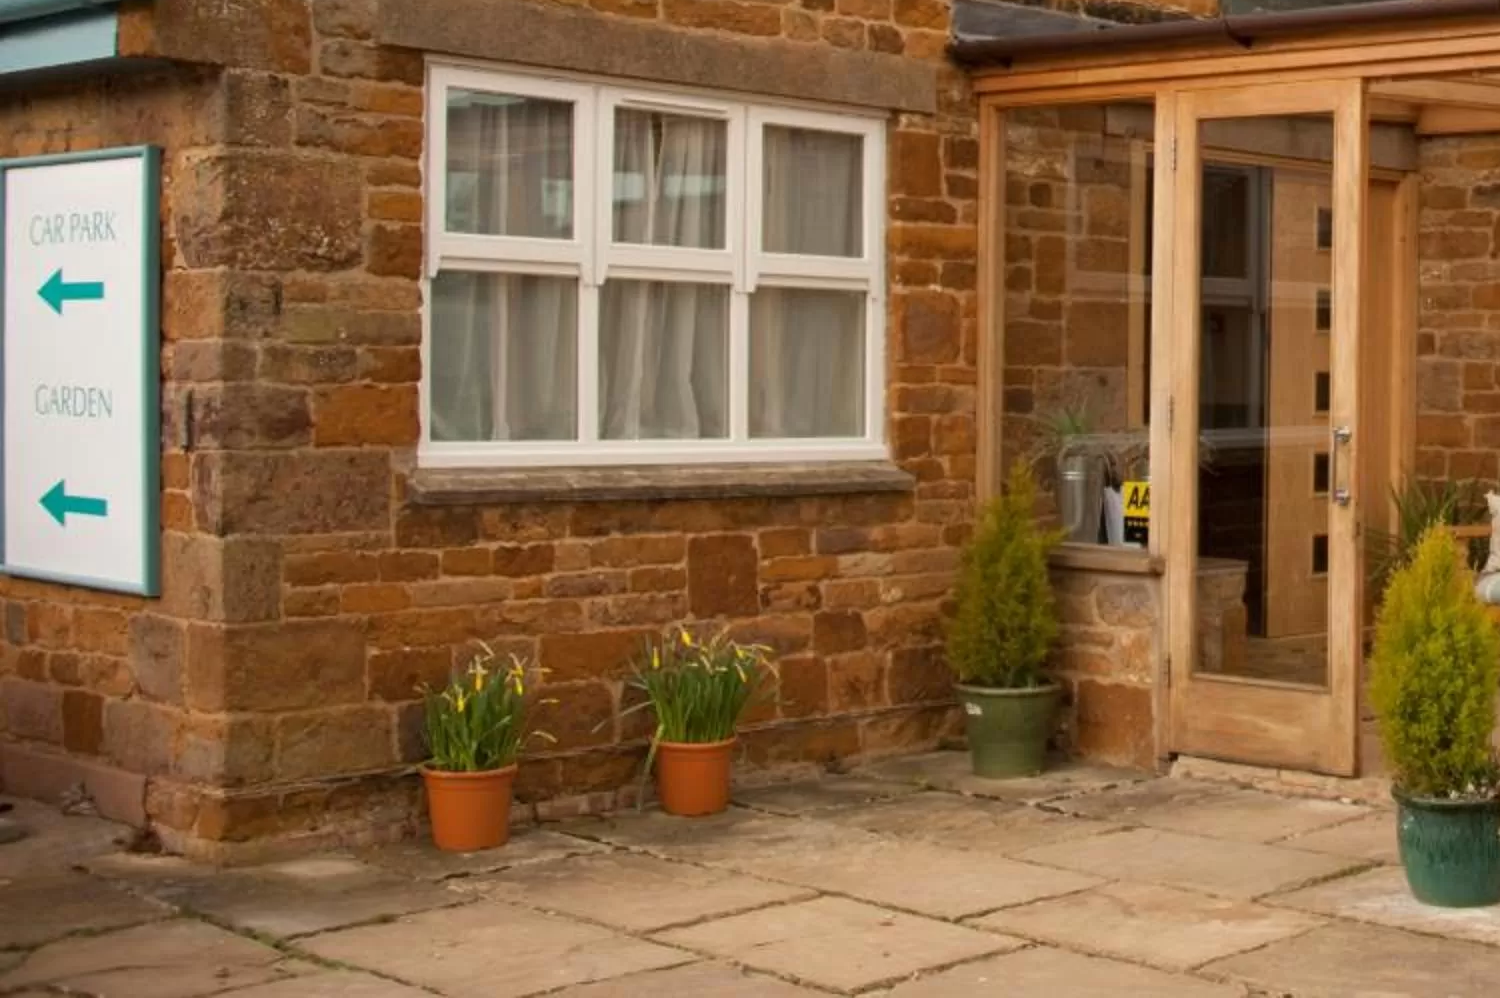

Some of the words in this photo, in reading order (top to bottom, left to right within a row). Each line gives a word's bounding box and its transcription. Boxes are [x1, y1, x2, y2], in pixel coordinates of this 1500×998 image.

[29, 213, 65, 246] CAR
[69, 210, 116, 242] PARK
[35, 384, 112, 418] GARDEN
[1127, 485, 1150, 510] AA
